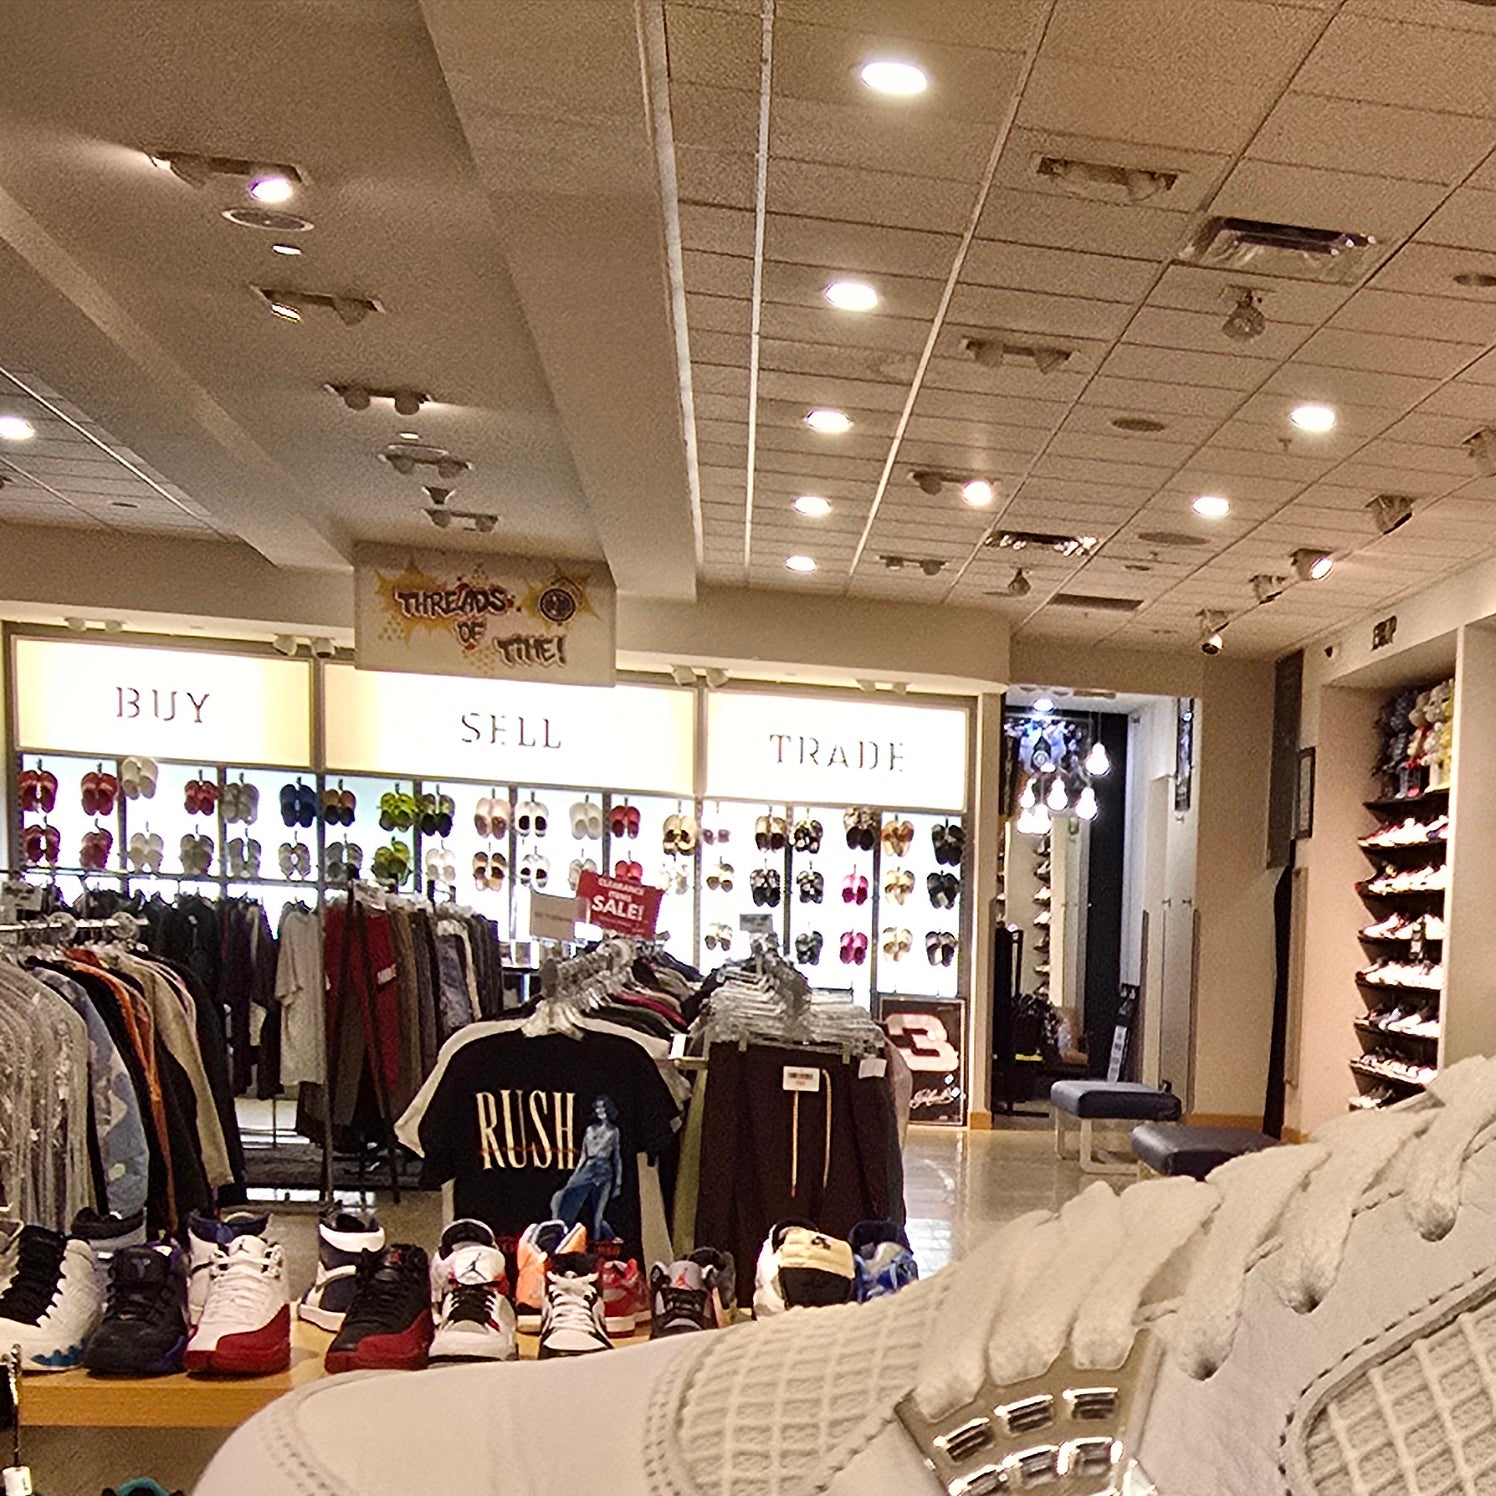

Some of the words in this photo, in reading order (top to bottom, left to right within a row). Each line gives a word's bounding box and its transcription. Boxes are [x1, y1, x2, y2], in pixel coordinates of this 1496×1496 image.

[456, 619, 484, 646] OF
[116, 686, 210, 723] BUY
[461, 712, 562, 749] SELL
[769, 734, 904, 773] TRADE
[591, 894, 645, 921] SALE!
[884, 1013, 959, 1071] 3
[475, 1089, 576, 1170] RUSH
